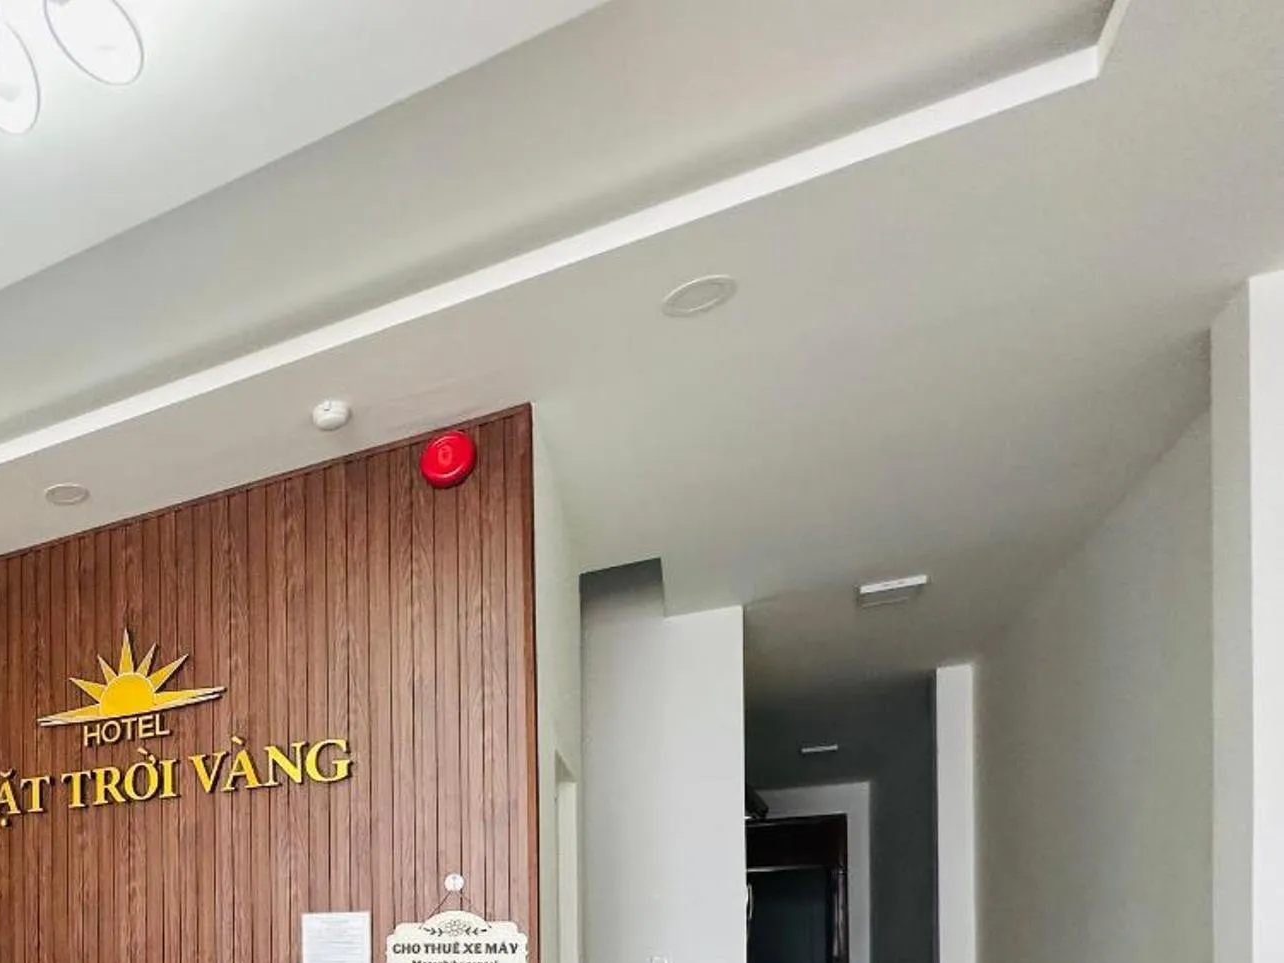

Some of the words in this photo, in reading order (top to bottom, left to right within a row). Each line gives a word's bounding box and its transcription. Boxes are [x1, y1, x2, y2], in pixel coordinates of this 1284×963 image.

[83, 714, 171, 746] HOTEL
[61, 747, 179, 810] TRỜI
[189, 736, 353, 793] VÀNG
[392, 942, 421, 954] CHO
[462, 942, 482, 954] XE
